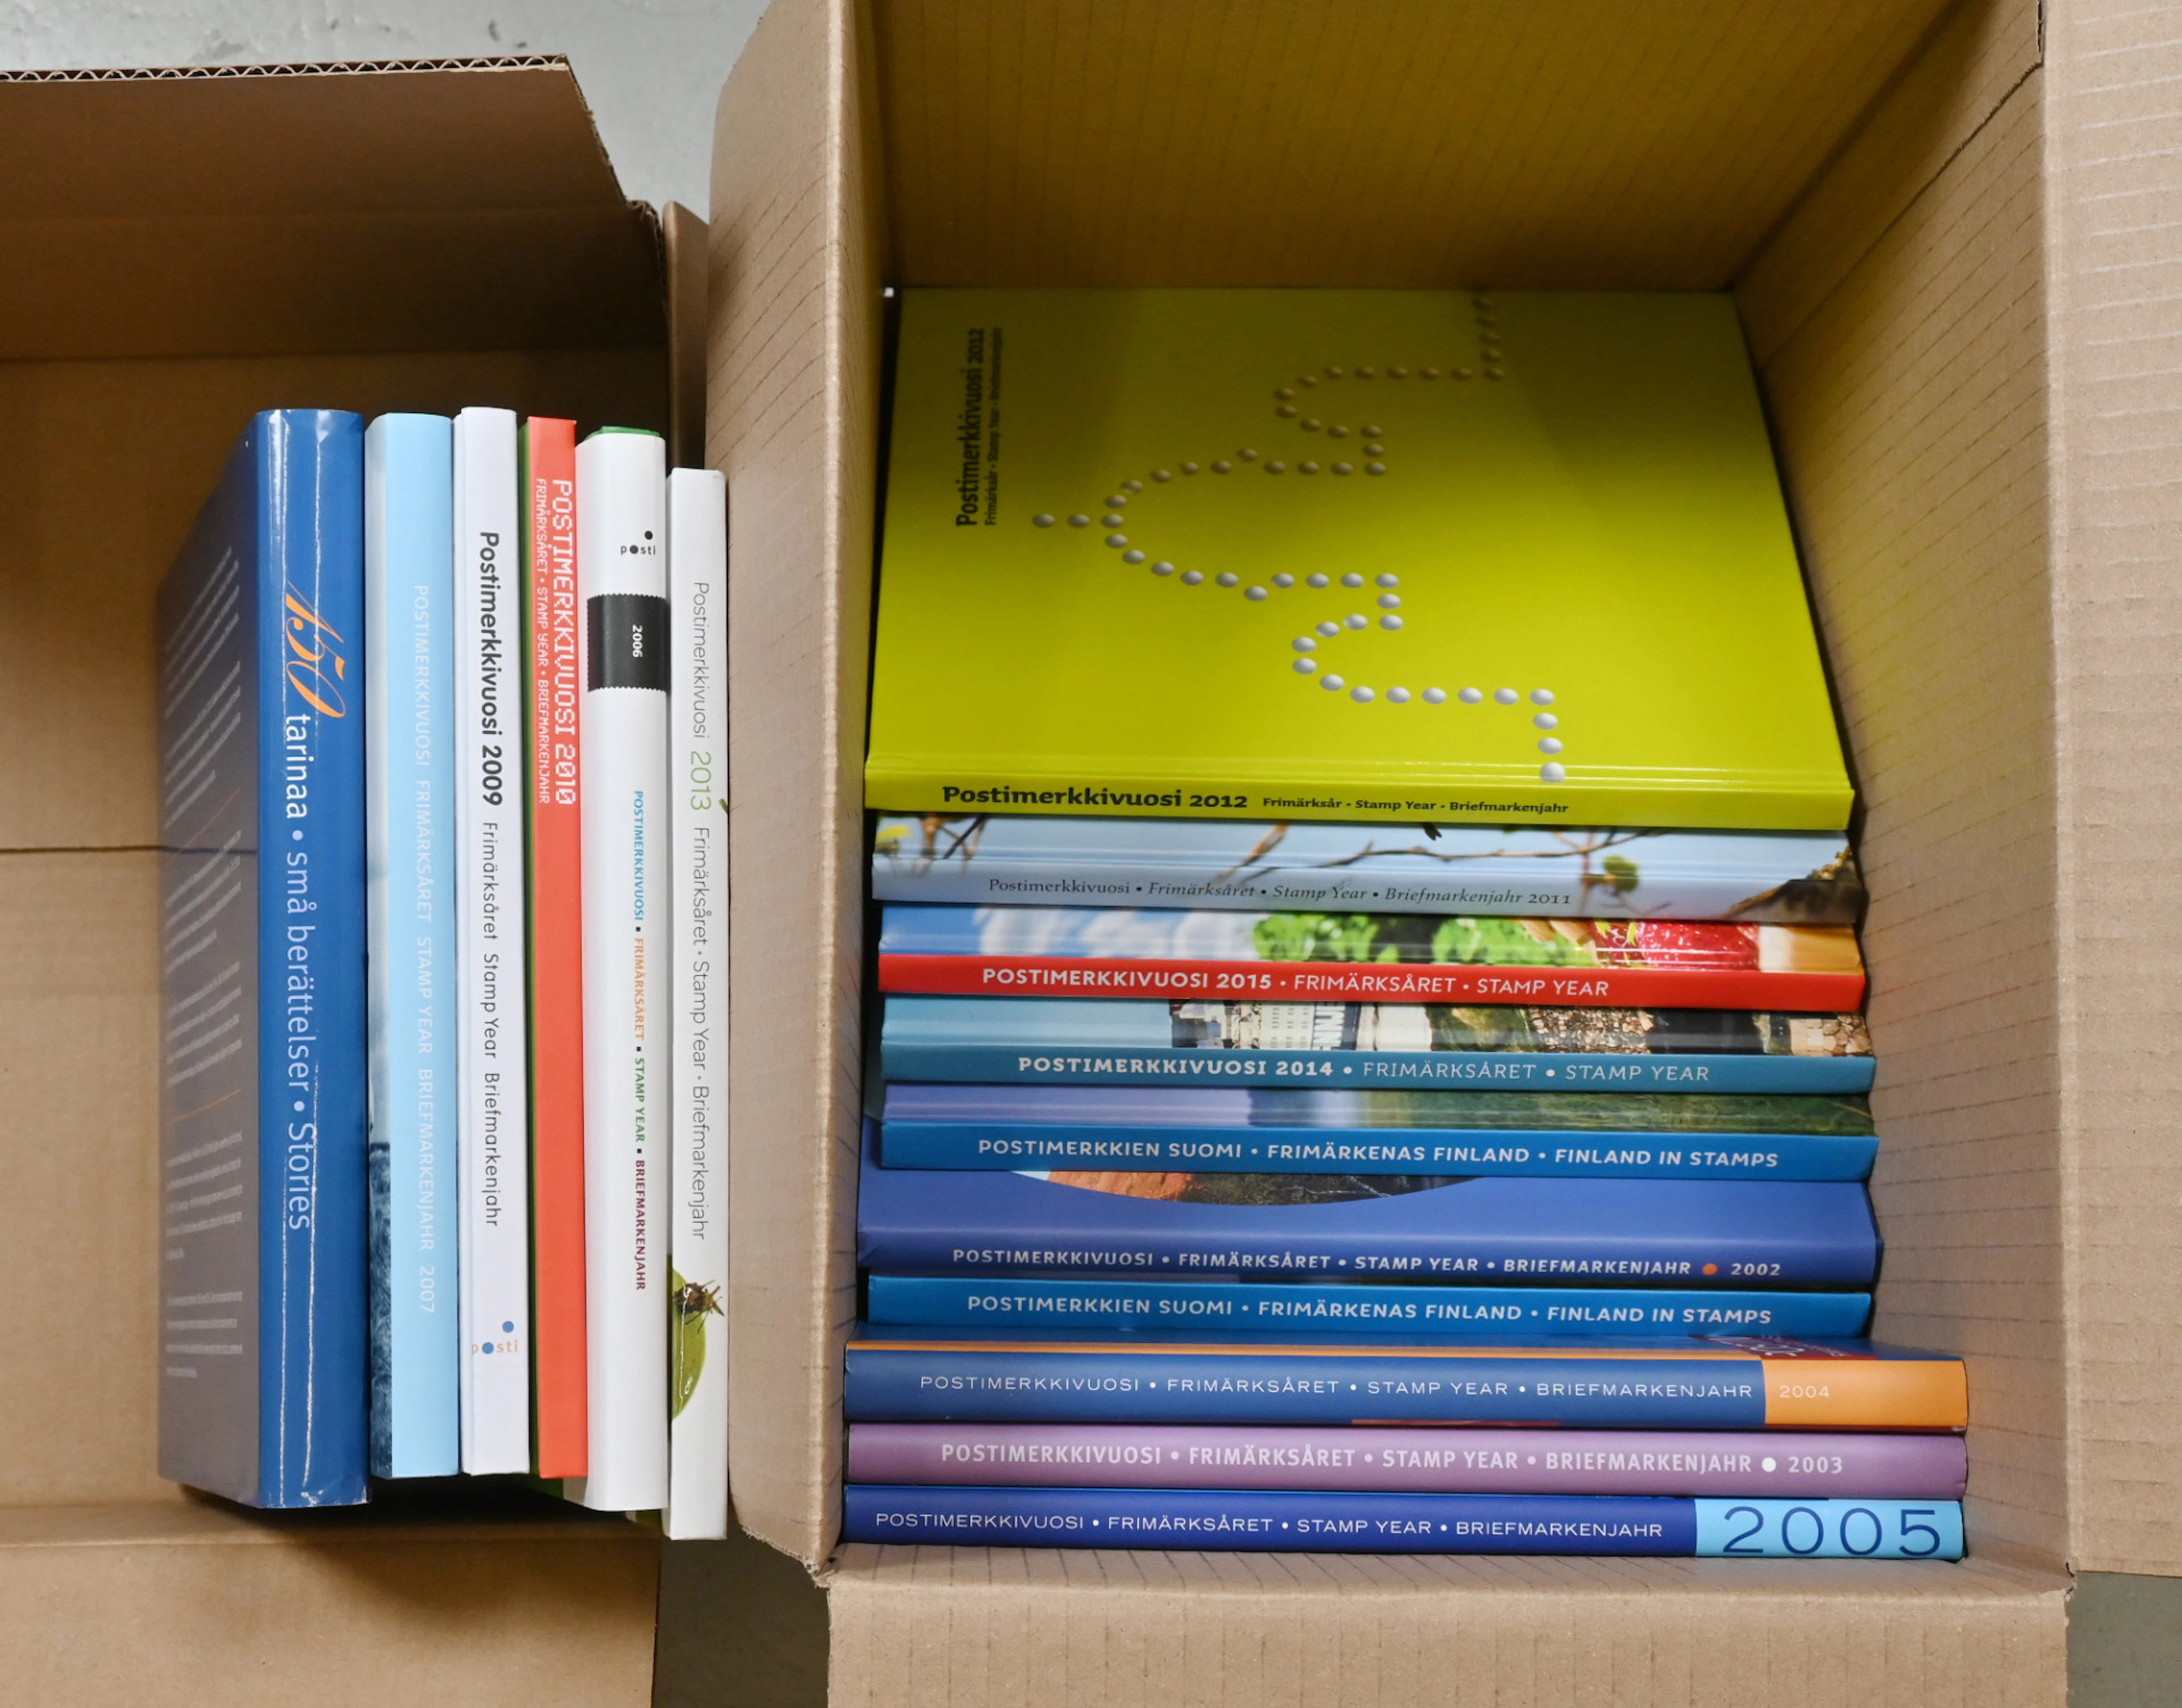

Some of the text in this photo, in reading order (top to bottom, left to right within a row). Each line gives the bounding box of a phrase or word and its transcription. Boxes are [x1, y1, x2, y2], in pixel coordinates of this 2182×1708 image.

[955, 328, 984, 527] Postimerkkivuosi 2012
[535, 478, 552, 805] FRIMÄRKSÅRET STAMP YEAR BRIEFMARKENJAHR
[552, 478, 576, 805] POSTIMERKKIVUOSI 2010
[633, 625, 643, 657] 2006
[943, 786, 1181, 806] Postimerkkivuosi
[1190, 795, 1247, 807] 2012
[1264, 798, 1342, 807] Frimärksår
[1356, 800, 1401, 811] Stamp
[1450, 801, 1568, 814] Briefmarkenjahr
[480, 532, 502, 1226] Postimerkkivuosi 2009 Frimärksåret Stamp Year Briefmarkenjahr
[990, 879, 1569, 905] Postimerkkivuosi Frimärksåret Stamp Year Briefmarkenjahr 2011
[285, 581, 345, 1232] 150 tarinaa små berättelser Stories
[688, 583, 713, 1240] Postimerkkivuosi 2013 Frimärksåret Stamp Year Briefmarkenjahr
[414, 585, 434, 1313] POSTIMERKKIVUOSI FRIMÄRKSÅRET STAMP YEAR BRIEFMARKENJAHR 2007
[984, 967, 1608, 995] POSTIMERKKIVUOSI 2015 FRIMÄRKSÅRET STAMP YEAR
[634, 791, 646, 1290] POSTIMERKKIVUOSI FRIMÄRKSÅRET STAMP YEAR BRIEFMARKENJAHR
[1019, 1057, 1708, 1081] POSTIMERKKIVUOSI 2014 FRIMÄRKSÅRET STAMP YEAR
[980, 1140, 1777, 1167] POSTIMERKKIEN SUOMI FRIMÄRKENAS FINLAND FINLAND IN STAMPS
[953, 1248, 1780, 1275] POSTIMERKKIVUOSI FRIMÄRKSÅRET STAMP YEAR BRIEFMARKENJAHR 2002
[969, 1297, 1771, 1323] POSTIMERKKIEN SUOMI FRIMÄRKENAS FINLAND FINLAND IN STAMPS
[921, 1377, 1829, 1398] POSTIMERKKIVUOSI FRIMÄRKSÅRET STAMP YEAR BRIEFMARKENJAHR 2004
[942, 1443, 1842, 1474] POSTIMERKKIVUOSI FRIMÄRKSÅRET STAMP YEAR BRIEFMARKENJAHR 2003
[877, 1507, 1941, 1557] POSTIMERKKIVUOSI FRIMÄRKSÅRET STAMP YEAR BRIEFMARKENJAHR 2005
